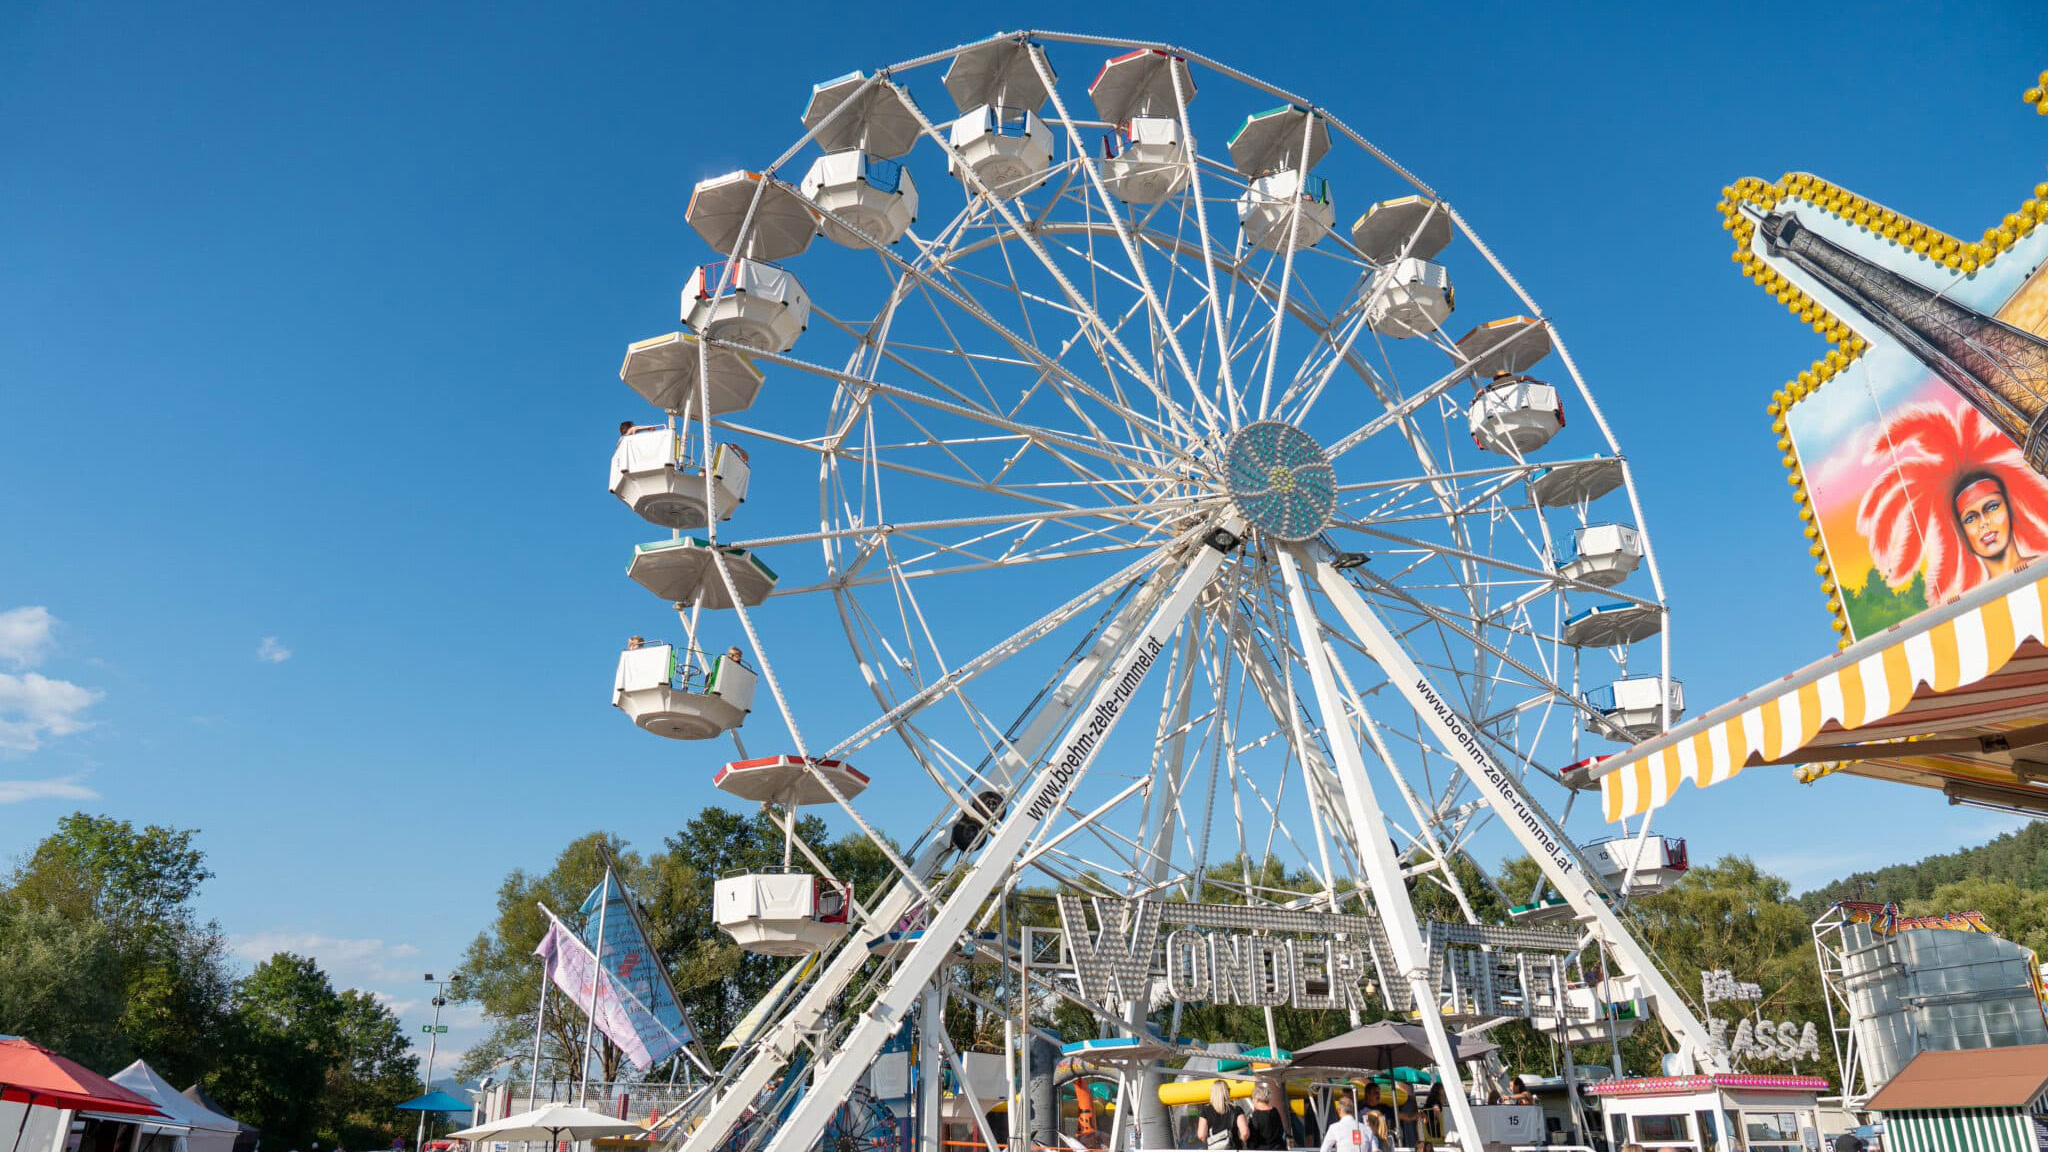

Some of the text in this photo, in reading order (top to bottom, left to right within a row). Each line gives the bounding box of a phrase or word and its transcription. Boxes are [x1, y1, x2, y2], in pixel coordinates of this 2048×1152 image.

[1026, 635, 1164, 821] www.boehm-zelte-rummel.at
[1416, 679, 1574, 875] www.boehm-zelte-rummel.at
[1599, 851, 1609, 860] 13
[731, 890, 736, 902] 1
[1057, 893, 1368, 1010] WONDER
[1709, 1017, 1821, 1062] KASSA
[1508, 1115, 1520, 1126] 15
